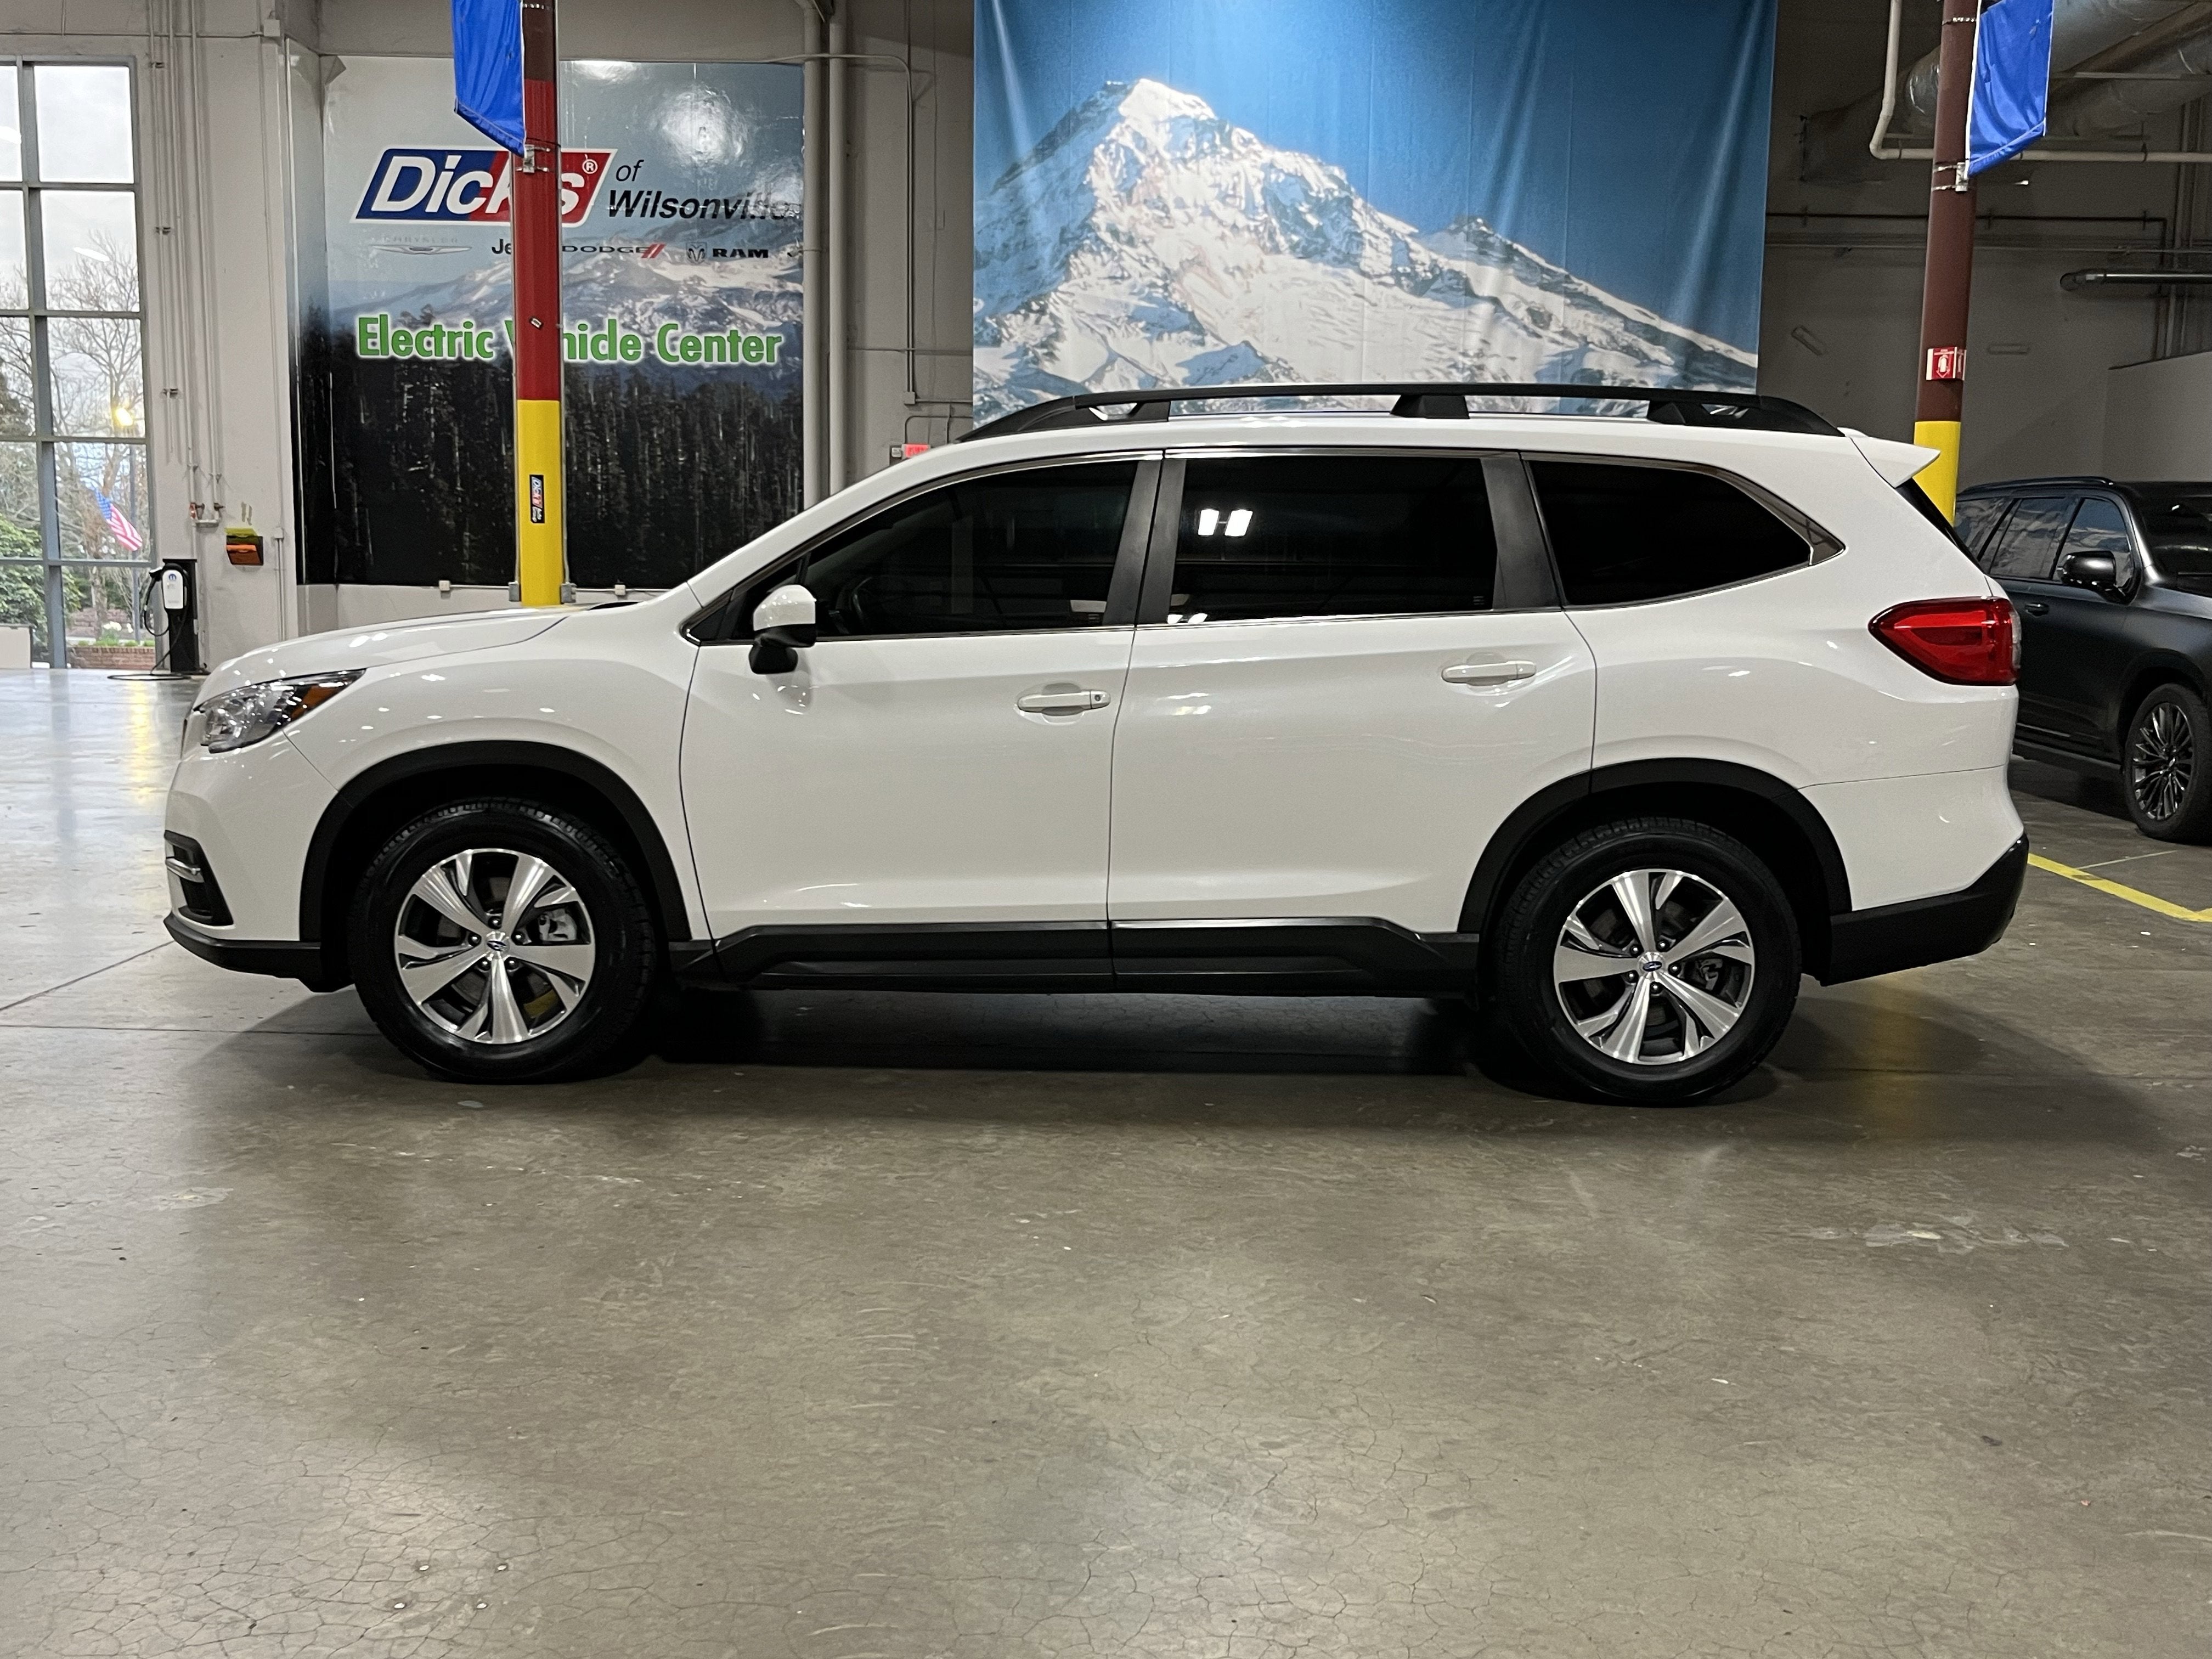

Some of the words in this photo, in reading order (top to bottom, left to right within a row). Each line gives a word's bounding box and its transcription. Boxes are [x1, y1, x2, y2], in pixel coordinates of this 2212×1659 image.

[616, 160, 644, 182] of
[713, 249, 769, 258] RAM
[358, 314, 493, 358] Electric
[658, 323, 782, 363] Center
